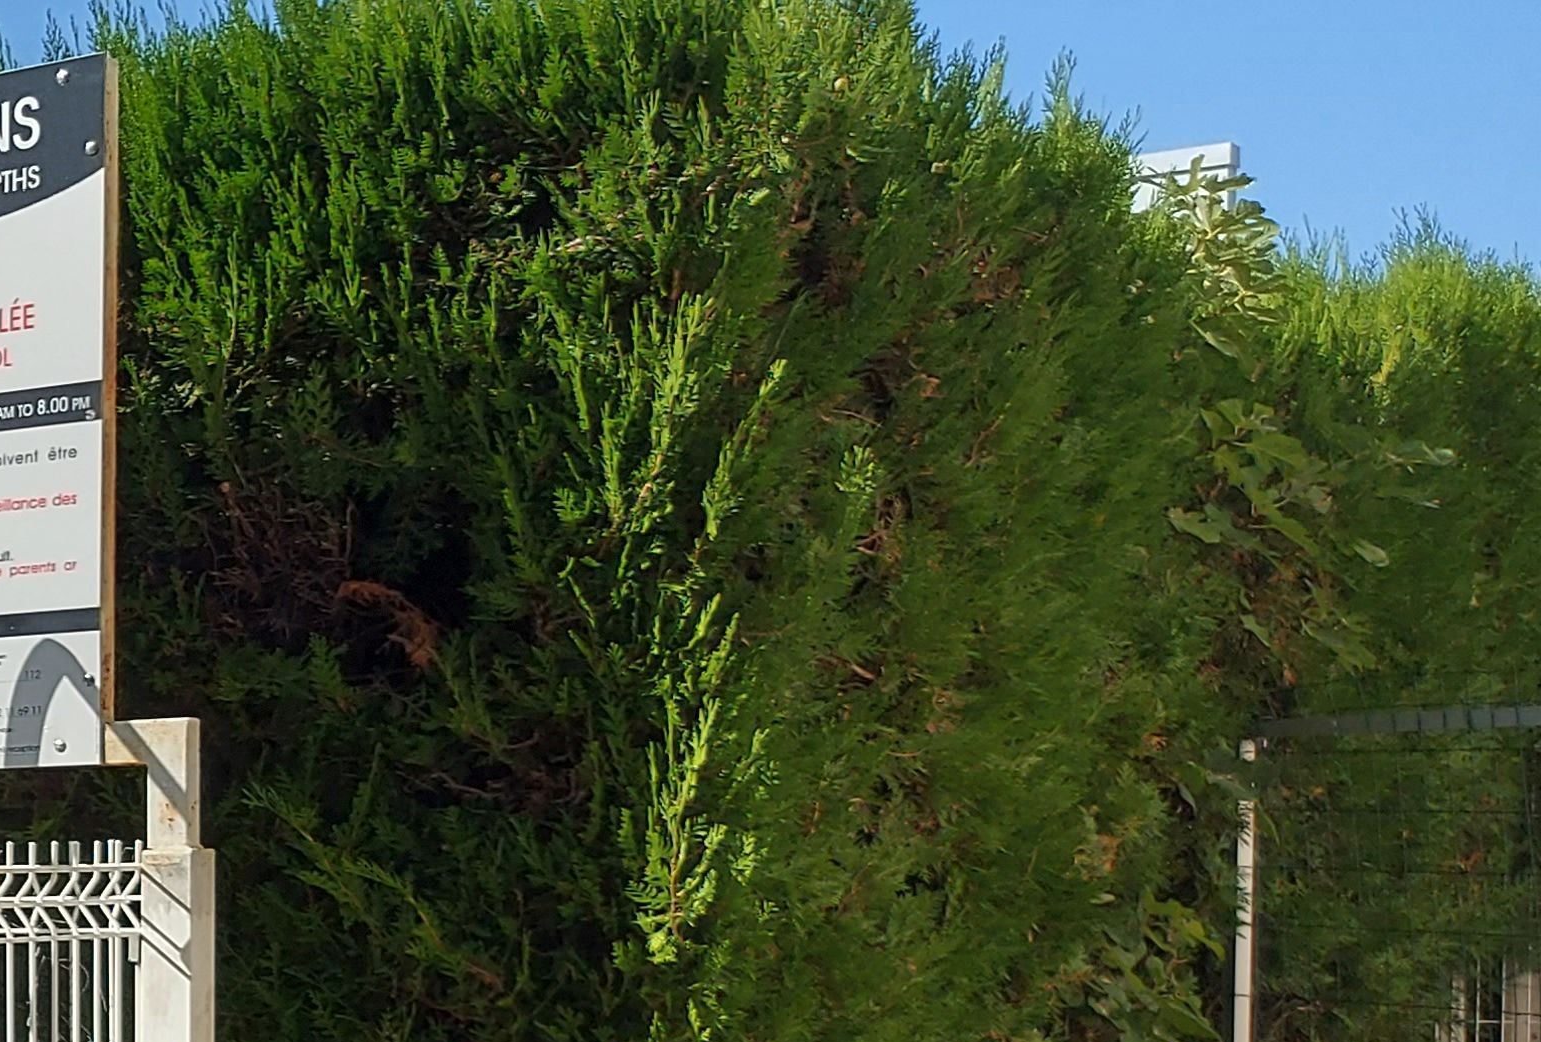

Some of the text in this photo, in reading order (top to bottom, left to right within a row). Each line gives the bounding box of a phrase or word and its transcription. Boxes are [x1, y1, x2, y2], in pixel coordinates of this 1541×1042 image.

[17, 403, 33, 417] TO
[37, 396, 69, 416] 8.00
[72, 395, 91, 411] PM
[47, 447, 78, 461] être
[52, 493, 77, 507] des
[25, 669, 41, 680] 112
